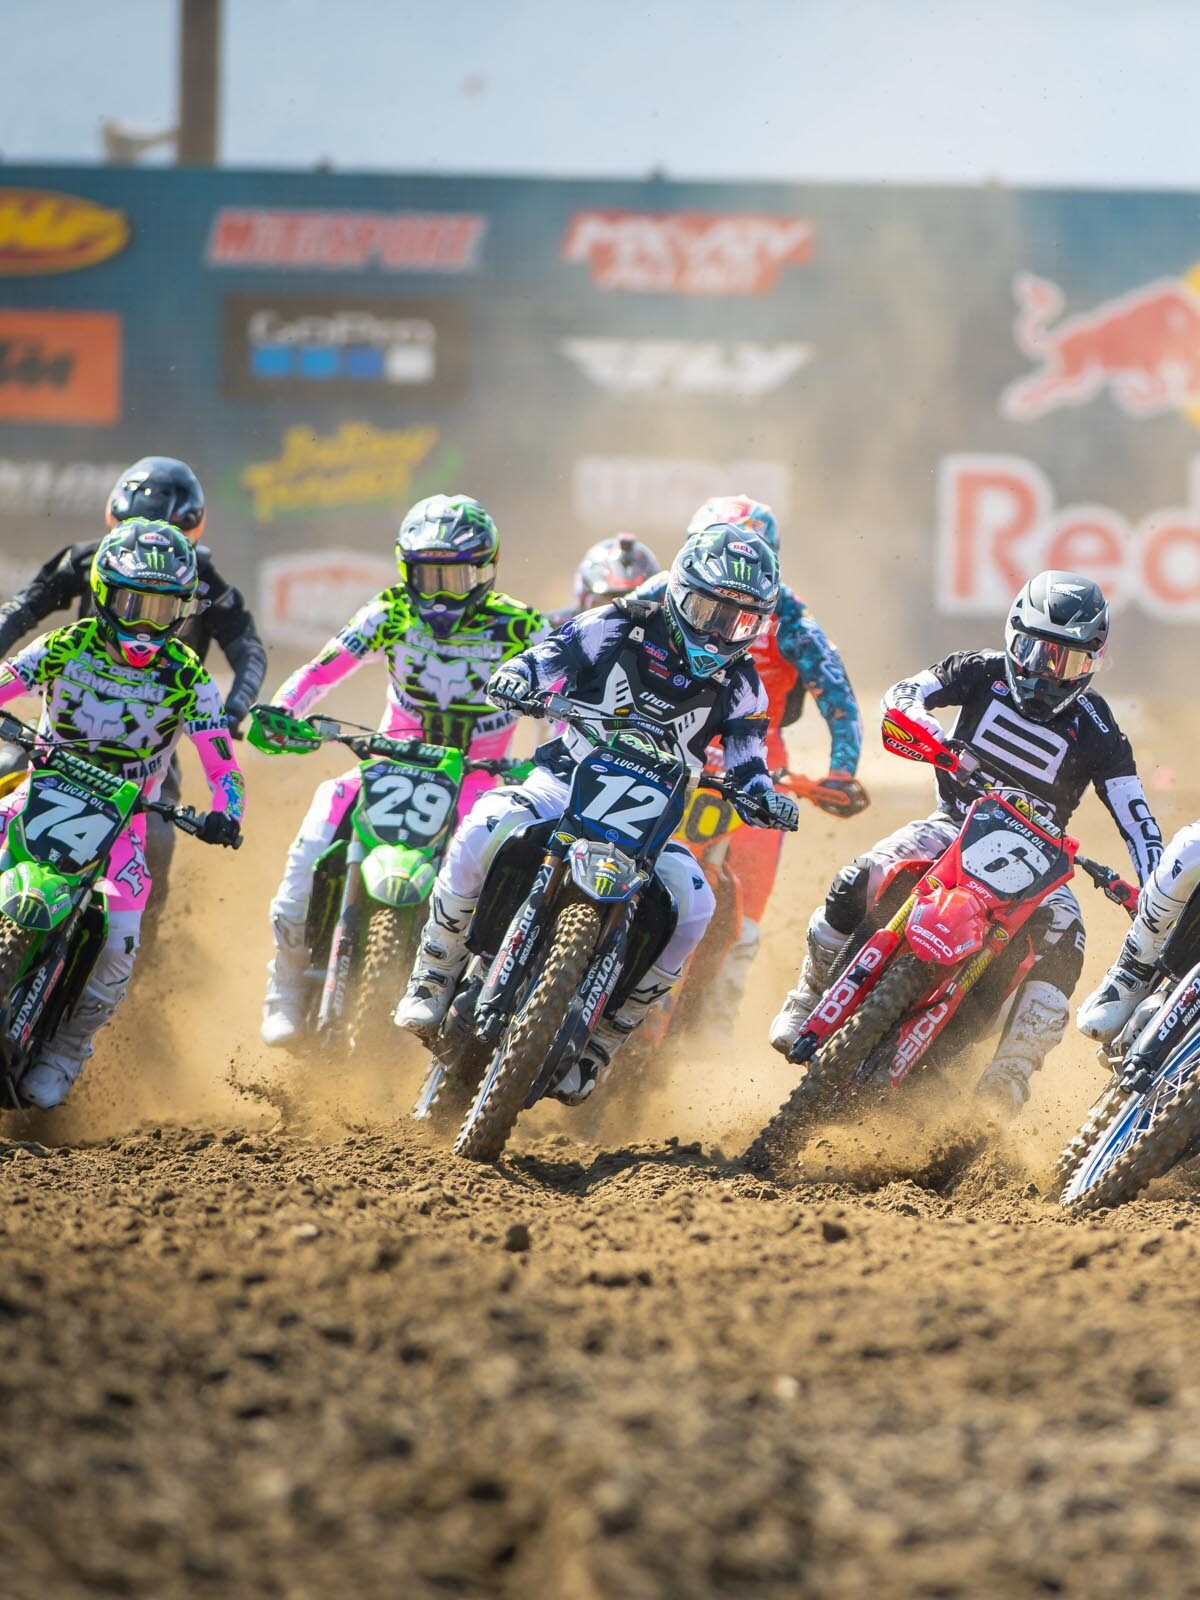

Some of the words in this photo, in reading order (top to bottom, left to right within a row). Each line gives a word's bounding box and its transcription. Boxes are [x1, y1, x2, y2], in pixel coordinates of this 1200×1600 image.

[732, 543, 755, 556] BELL
[721, 579, 762, 595] MONSTER
[1051, 588, 1083, 602] HONDA
[62, 660, 166, 704] Kawasaki
[638, 689, 676, 712] thor
[1076, 693, 1110, 735] GEICO
[886, 736, 924, 762] CYCRA
[387, 764, 418, 779] LUCAS
[419, 769, 436, 782] OIL
[613, 757, 646, 775] LUCAS
[645, 769, 661, 783] OIL
[57, 781, 90, 800] LUCAS
[89, 796, 106, 811] OIL
[366, 774, 451, 837] 29
[581, 774, 670, 840] 12
[25, 787, 118, 866] 74
[1003, 816, 1032, 839] LUCAS
[1031, 834, 1047, 851] OIL
[961, 829, 1051, 894] 6
[966, 879, 993, 900] SHIFT
[911, 924, 954, 959] GEICO
[911, 934, 942, 959] HONDA
[819, 945, 883, 1025] GICO
[11, 966, 49, 1040] DUNLOP
[889, 1002, 950, 1080] GEICO
